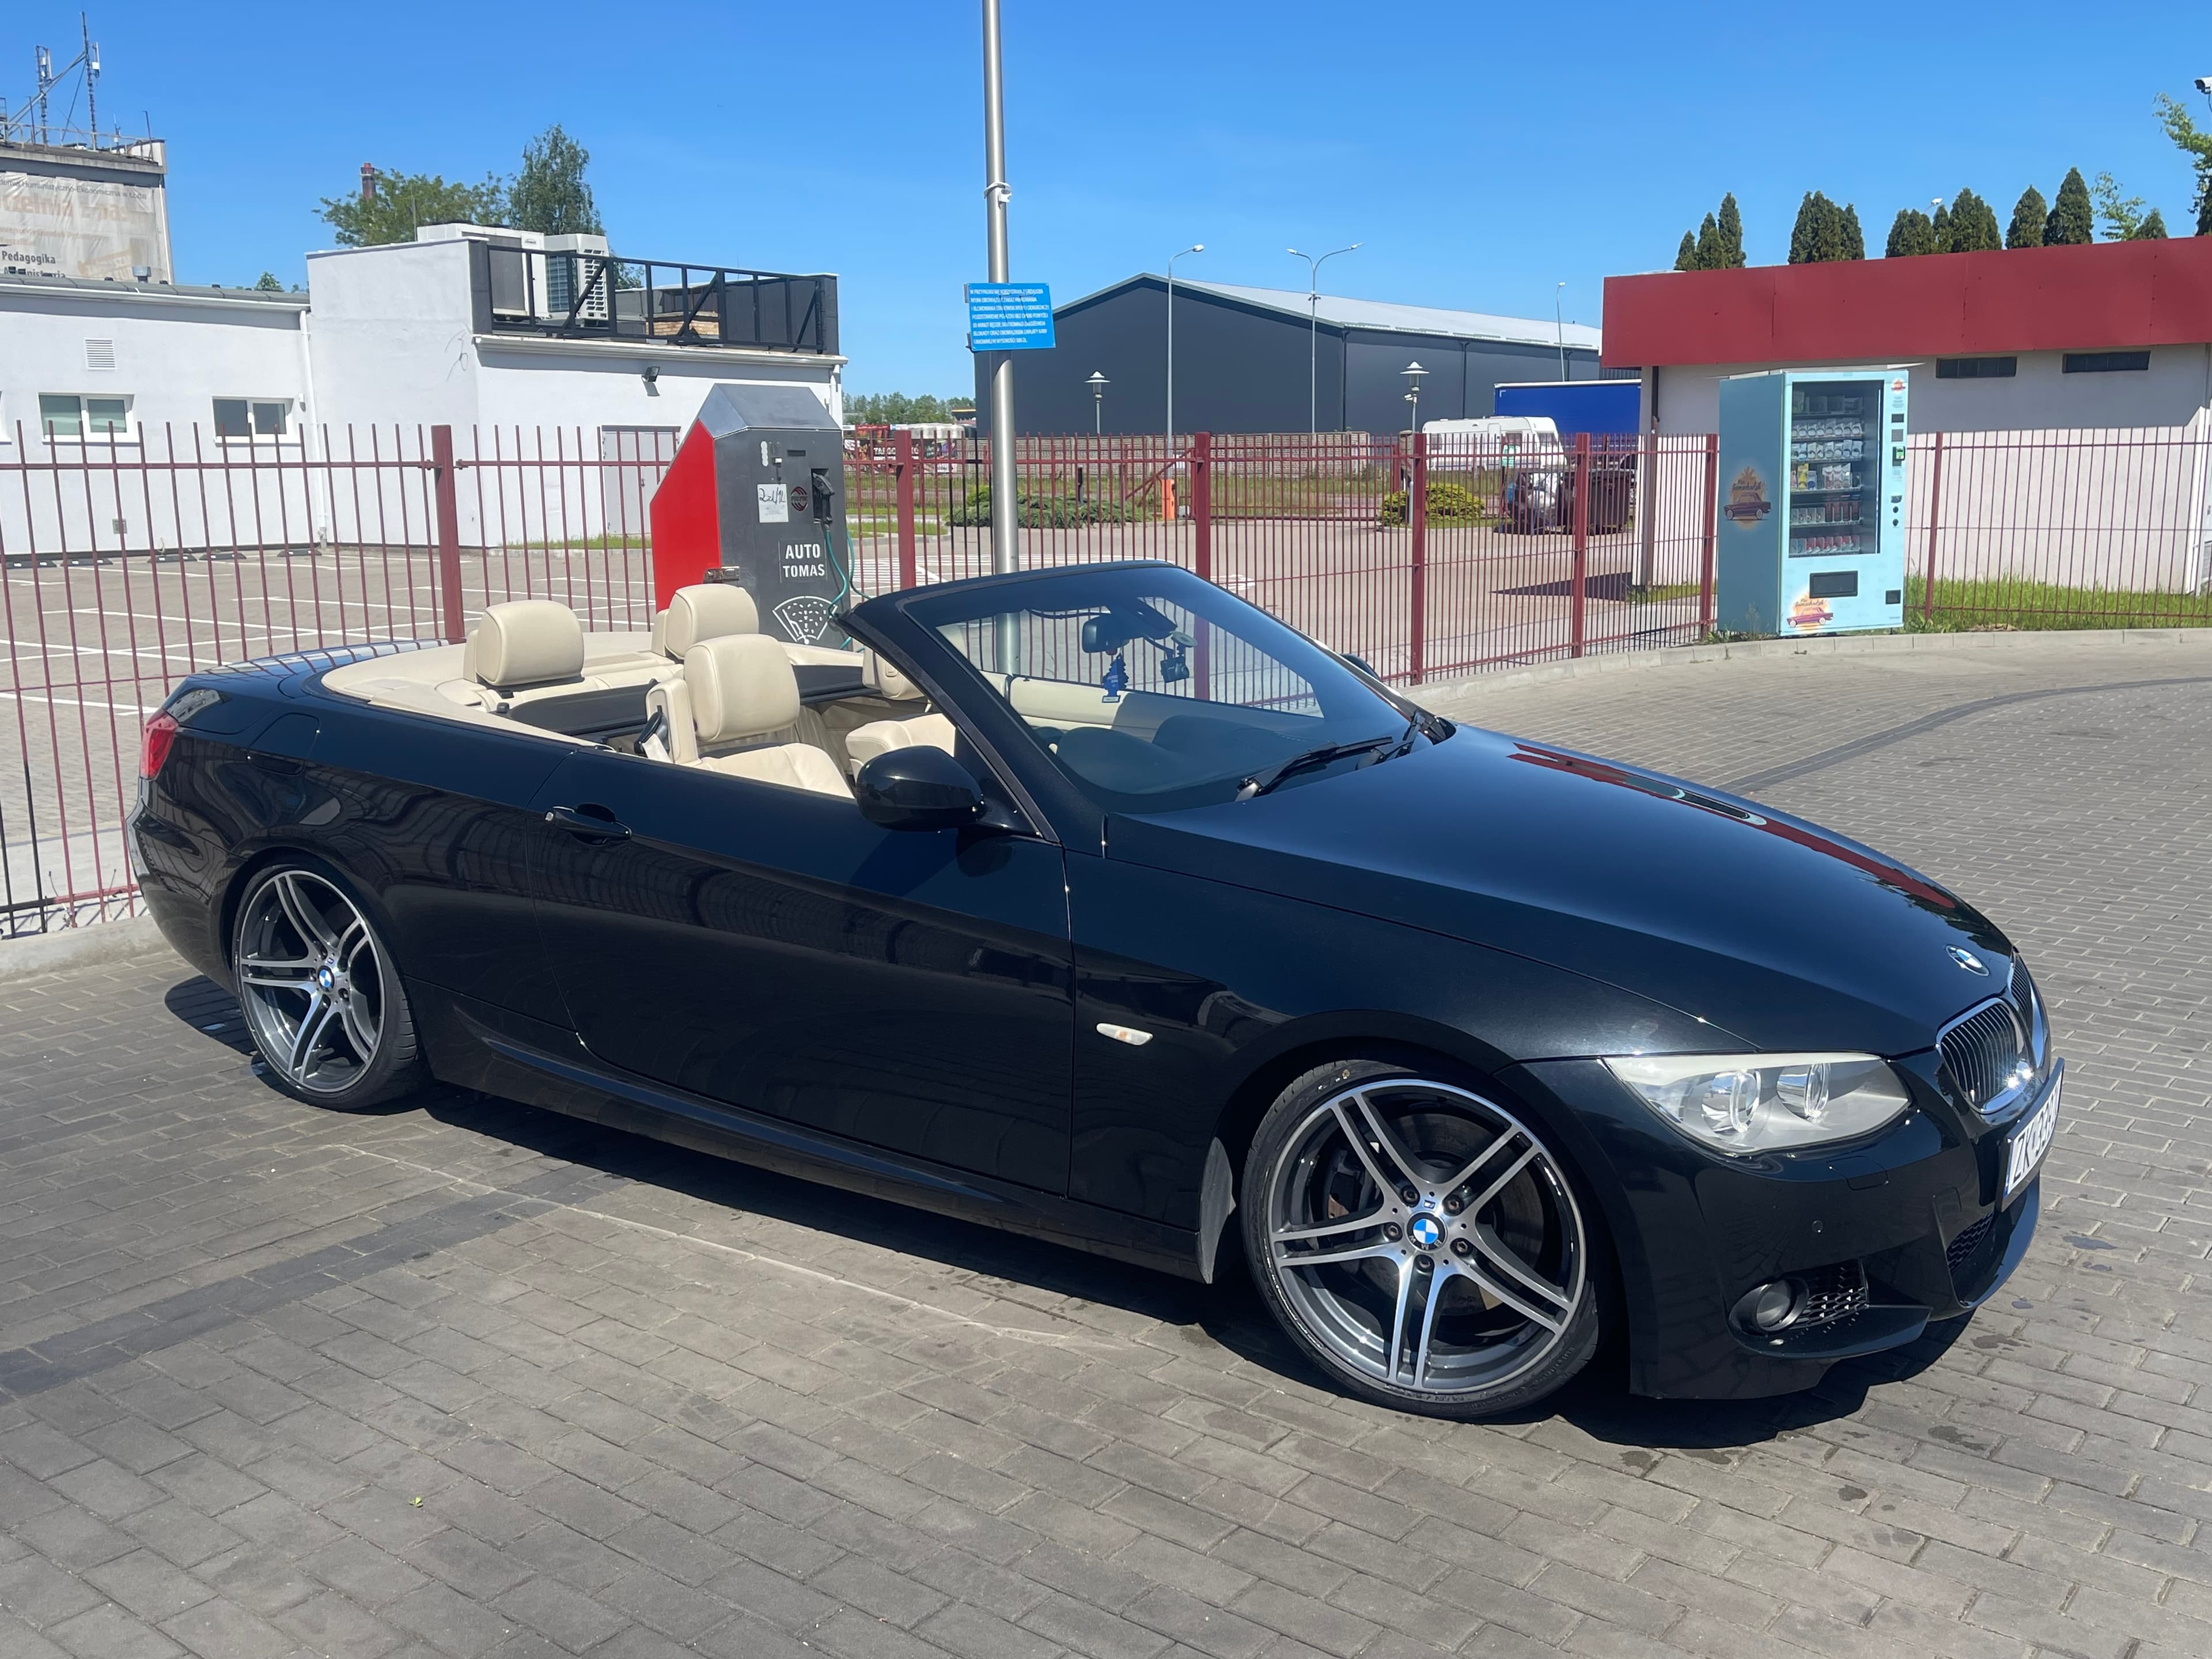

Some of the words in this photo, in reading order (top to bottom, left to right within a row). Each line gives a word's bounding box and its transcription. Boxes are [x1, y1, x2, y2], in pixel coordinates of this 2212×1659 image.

[2, 251, 56, 266] Pedagogika
[785, 543, 820, 559] AUTO
[782, 563, 825, 578] TOMAS
[1409, 1234, 1443, 1251] BMW
